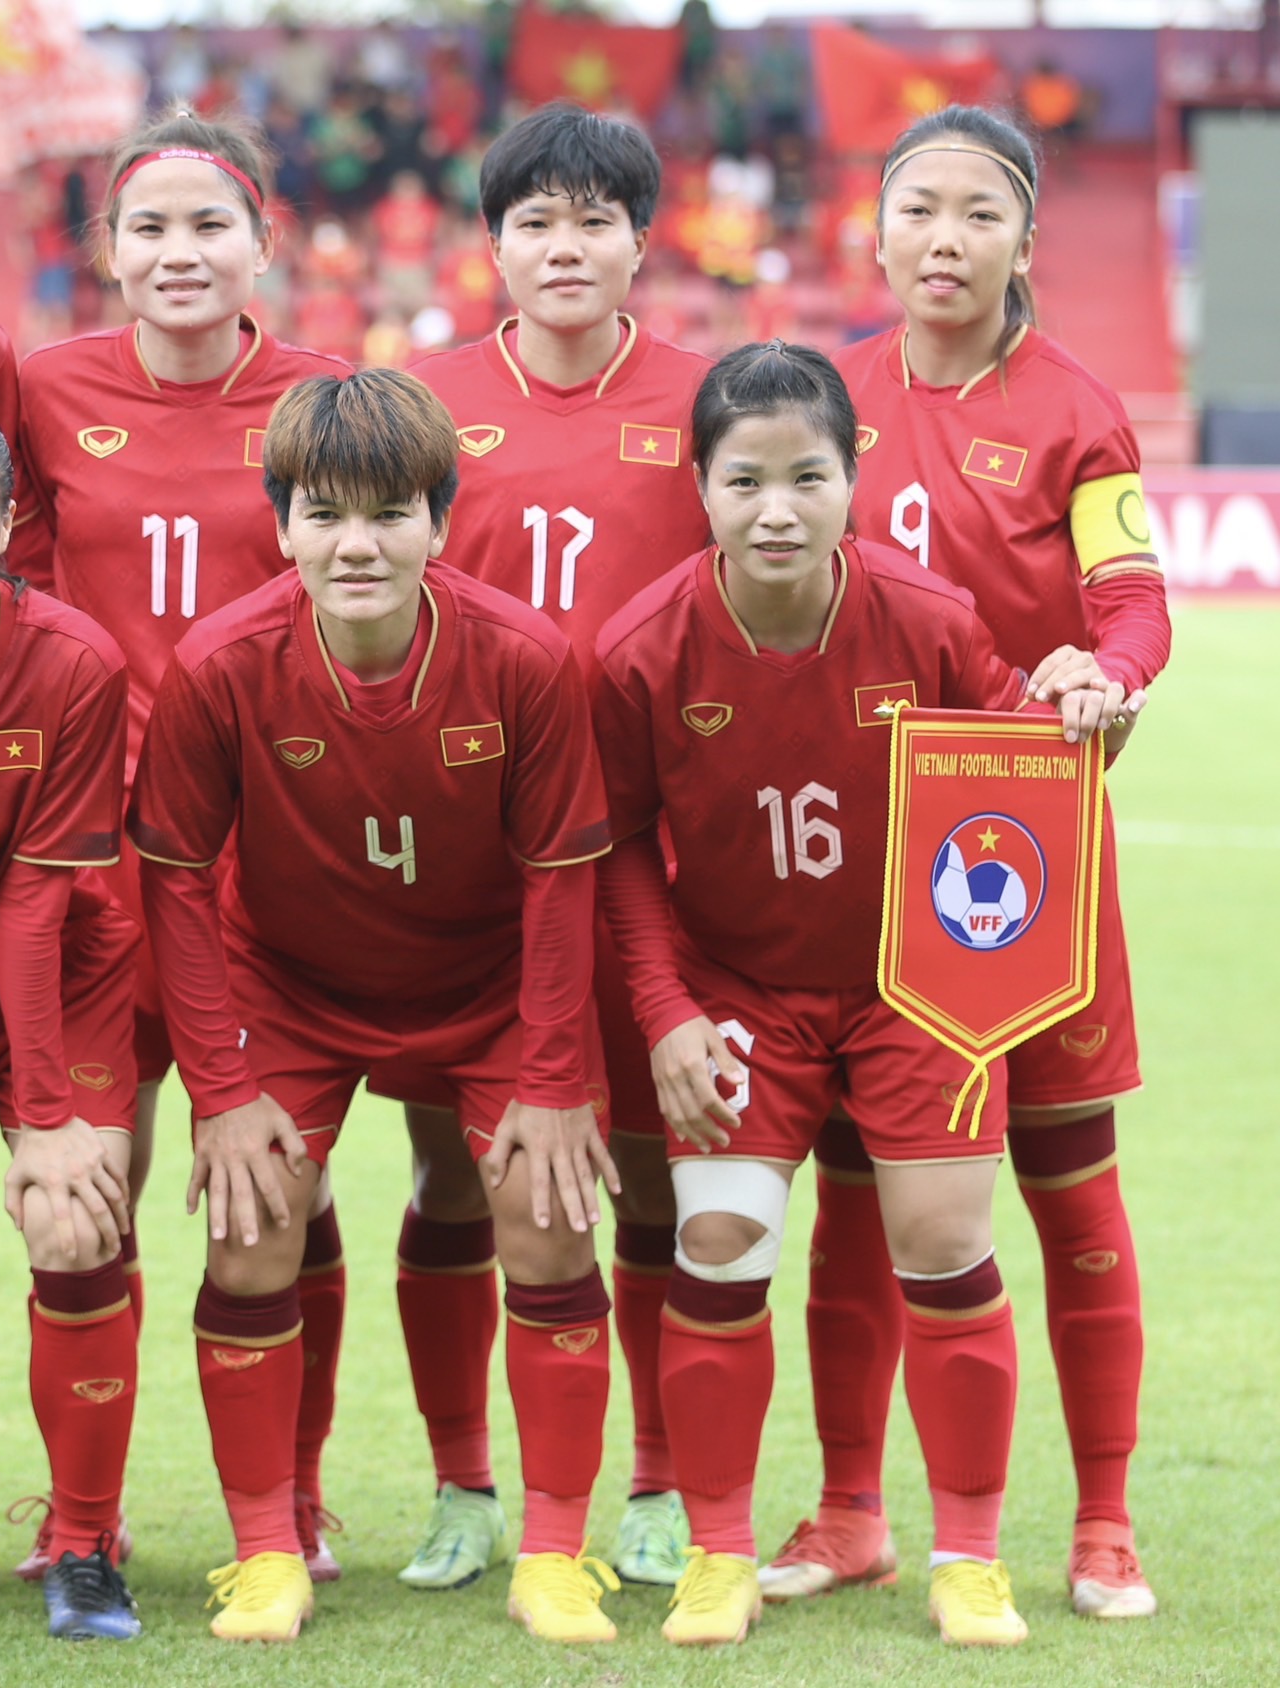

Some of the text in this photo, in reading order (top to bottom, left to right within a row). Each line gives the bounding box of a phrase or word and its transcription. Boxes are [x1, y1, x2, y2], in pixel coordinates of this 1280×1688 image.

[159, 149, 199, 159] adidas
[889, 481, 930, 569] 9
[1116, 489, 1150, 545] C
[142, 513, 199, 619] 11
[522, 504, 595, 612] 17
[915, 753, 1076, 780] VIETNAM FOOTBALL FEDERATION
[364, 815, 416, 885] 4
[756, 781, 843, 880] 16
[969, 915, 1003, 932] VFF
